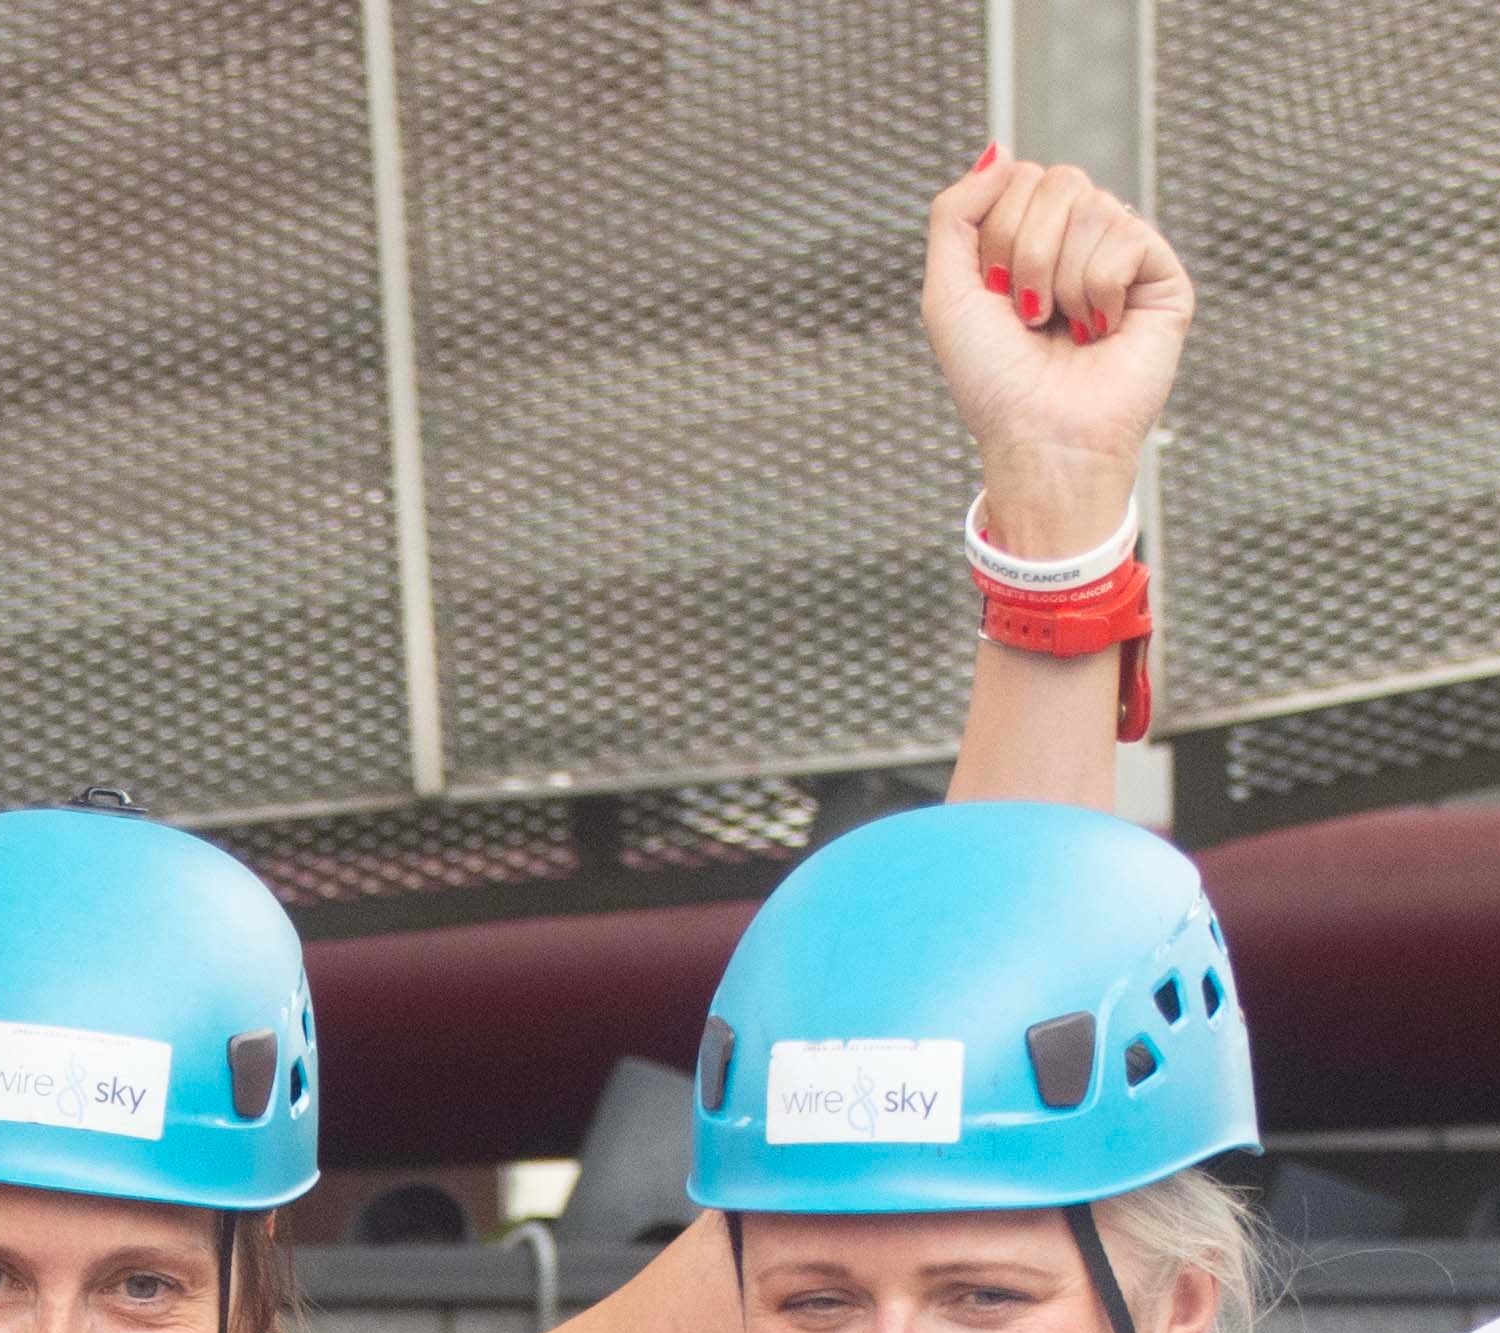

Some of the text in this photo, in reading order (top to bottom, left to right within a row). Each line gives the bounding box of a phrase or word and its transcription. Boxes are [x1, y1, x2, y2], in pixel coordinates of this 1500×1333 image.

[1022, 569, 1081, 583] CANCER
[1070, 581, 1114, 602] CANCER
[95, 1076, 147, 1114] sky
[781, 1084, 843, 1114] wire
[884, 1082, 938, 1119] sky
